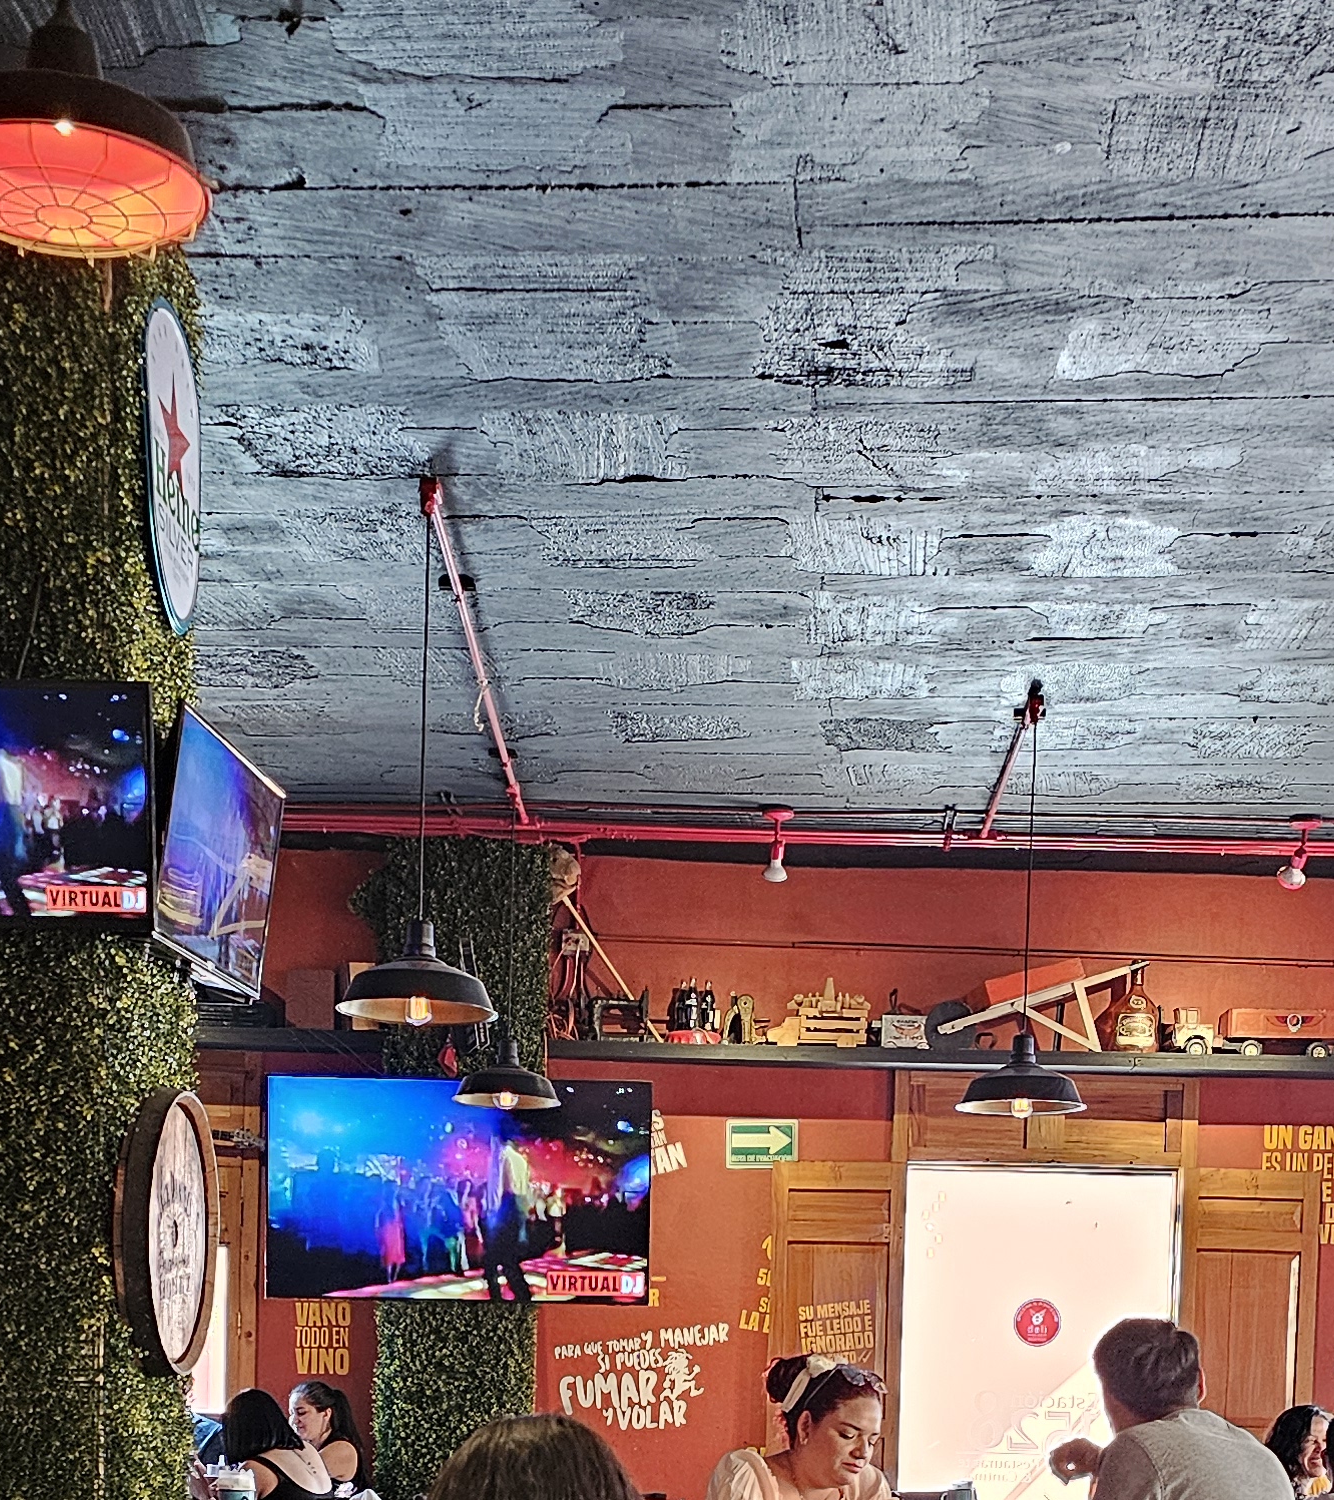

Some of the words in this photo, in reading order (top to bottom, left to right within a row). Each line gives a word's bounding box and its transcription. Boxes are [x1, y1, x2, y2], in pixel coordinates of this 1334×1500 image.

[155, 438, 200, 552] Heine
[1263, 1125, 1293, 1150] UN
[295, 1301, 351, 1326] VANO
[798, 1304, 814, 1321] SU
[817, 1300, 871, 1318] MENSAJE
[295, 1326, 329, 1347] TODO
[332, 1327, 349, 1347] EN
[799, 1322, 824, 1337] FUE
[864, 1315, 873, 1330] E
[554, 1344, 581, 1359] PARA
[584, 1341, 603, 1355] QUE
[606, 1337, 641, 1353] TOMAR
[660, 1322, 730, 1349] MANEJAR
[800, 1331, 874, 1355] IGNORADO
[295, 1348, 349, 1375] VINO
[597, 1351, 610, 1374] SI
[616, 1349, 664, 1370] PUEDES
[560, 1370, 657, 1415] FUMAR
[616, 1400, 687, 1431] VOLAR
